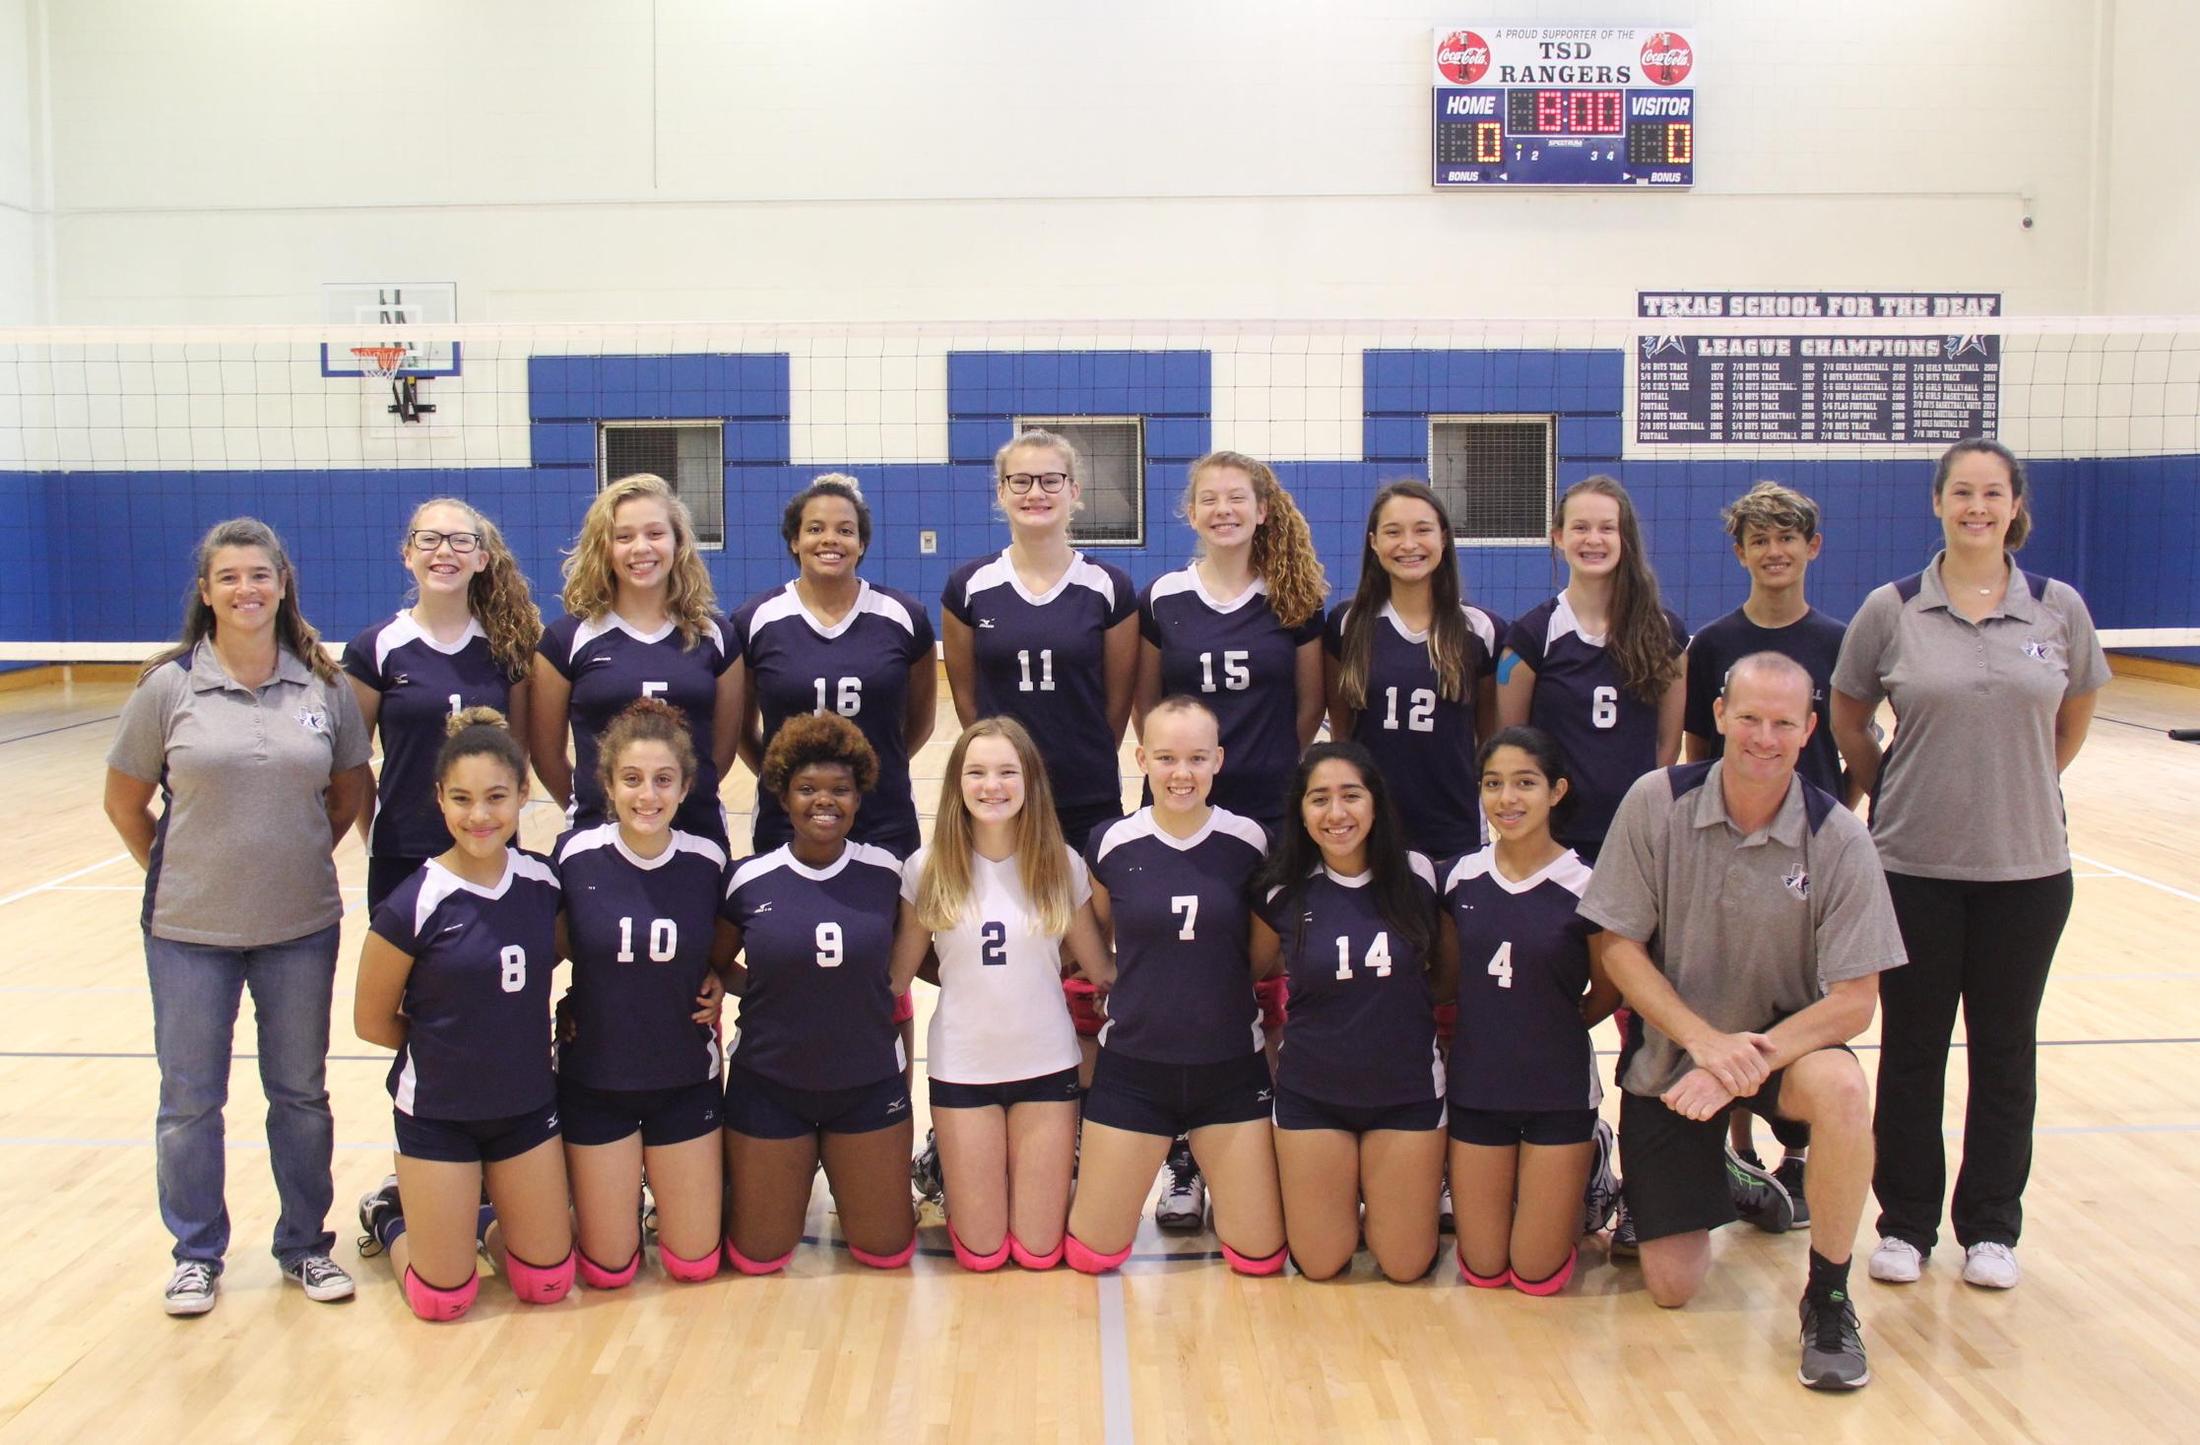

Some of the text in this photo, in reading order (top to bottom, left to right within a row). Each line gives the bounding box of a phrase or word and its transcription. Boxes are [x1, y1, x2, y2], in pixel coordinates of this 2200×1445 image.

[1496, 30, 1635, 39] A PROUD SUPPORTER OF THE
[1539, 42, 1592, 59] TSD
[1499, 65, 1631, 83] RANGERS
[1446, 96, 1496, 115] HOME
[1631, 97, 1691, 116] VISITOR
[1538, 91, 1620, 131] 8:00
[1477, 122, 1500, 162] 0
[1668, 123, 1691, 163] 0
[1515, 151, 1614, 161] 1 2 3 4
[1448, 171, 1479, 182] BONUS
[1650, 172, 1681, 183] BONUS
[1643, 296, 1996, 317] TEXAS SCHOOL FOR THE DEAF
[1698, 338, 1940, 357] LEAGUE CHAMPIONS
[1653, 362, 1668, 371] BOYS
[1669, 362, 1688, 371] TRACK
[1745, 362, 1760, 371] BOYS
[1762, 362, 1780, 371] TRACK
[1835, 363, 1852, 371] GIRLS
[1853, 363, 1888, 371] BASKETBALL
[1926, 364, 1942, 372] GIRLS
[1944, 364, 1979, 372] VOLLEYBALL
[1652, 372, 1668, 381] BOYS
[1669, 372, 1688, 381] TRACK
[1745, 372, 1760, 381] BOYS
[1761, 372, 1780, 381] TRACK
[1829, 372, 1843, 381] BOYS
[1844, 372, 1880, 381] BASKETBALL
[1925, 373, 1940, 382] BOYS
[1942, 373, 1960, 382] TRACK
[1652, 382, 1669, 391] GIRLS
[1671, 382, 1690, 391] TRACK
[1745, 382, 1760, 391] BOYS
[1835, 383, 1851, 391] GIRLS
[1852, 383, 1888, 391] BASKETBALL
[1640, 392, 1669, 401] FOOTBALL
[1744, 392, 1759, 401] BOYS
[1761, 392, 1779, 401] TRACK
[1835, 392, 1850, 401] BOYS
[1851, 392, 1887, 401] BASKETBALL
[1925, 392, 1941, 401] GIRLS
[1942, 392, 1978, 401] BASKETBALL
[1640, 402, 1669, 411] FOOTBALL
[1744, 402, 1759, 411] BOYS
[1761, 402, 1780, 411] TRACK
[1834, 402, 1849, 411] FLAG
[1849, 402, 1877, 411] FOOTBALL
[1652, 412, 1668, 421] BOYS
[1669, 412, 1688, 421] TRACK
[1744, 412, 1759, 420] BOYS
[1760, 412, 1796, 420] BASKETBALL
[1834, 412, 1849, 421] FLAG
[1652, 422, 1668, 430] BOYS
[1669, 422, 1704, 430] BASKETBALL
[1744, 422, 1759, 430] BOYS
[1760, 422, 1779, 430] TRACK
[1835, 422, 1850, 430] BOYS
[1851, 422, 1870, 430] TRACK
[1640, 432, 1668, 440] FOOTBALL
[1744, 432, 1760, 440] GIRLS
[1762, 432, 1797, 440] BASKETBALL
[1833, 432, 1850, 440] GIRLS
[1852, 432, 1886, 440] VOLLEYBALL
[1926, 430, 1940, 439] BOYS
[1942, 430, 1960, 439] TRACK
[1017, 649, 1055, 691] 11
[1199, 650, 1250, 692] 15
[813, 676, 862, 718] 16
[1383, 686, 1436, 732] 12
[1592, 686, 1617, 728] 6
[1171, 895, 1199, 940] 7
[617, 916, 678, 963] 10
[815, 921, 843, 967] 9
[981, 921, 1007, 966] 2
[1335, 931, 1392, 980] 14
[500, 944, 526, 993] 8
[1487, 941, 1513, 988] 4
